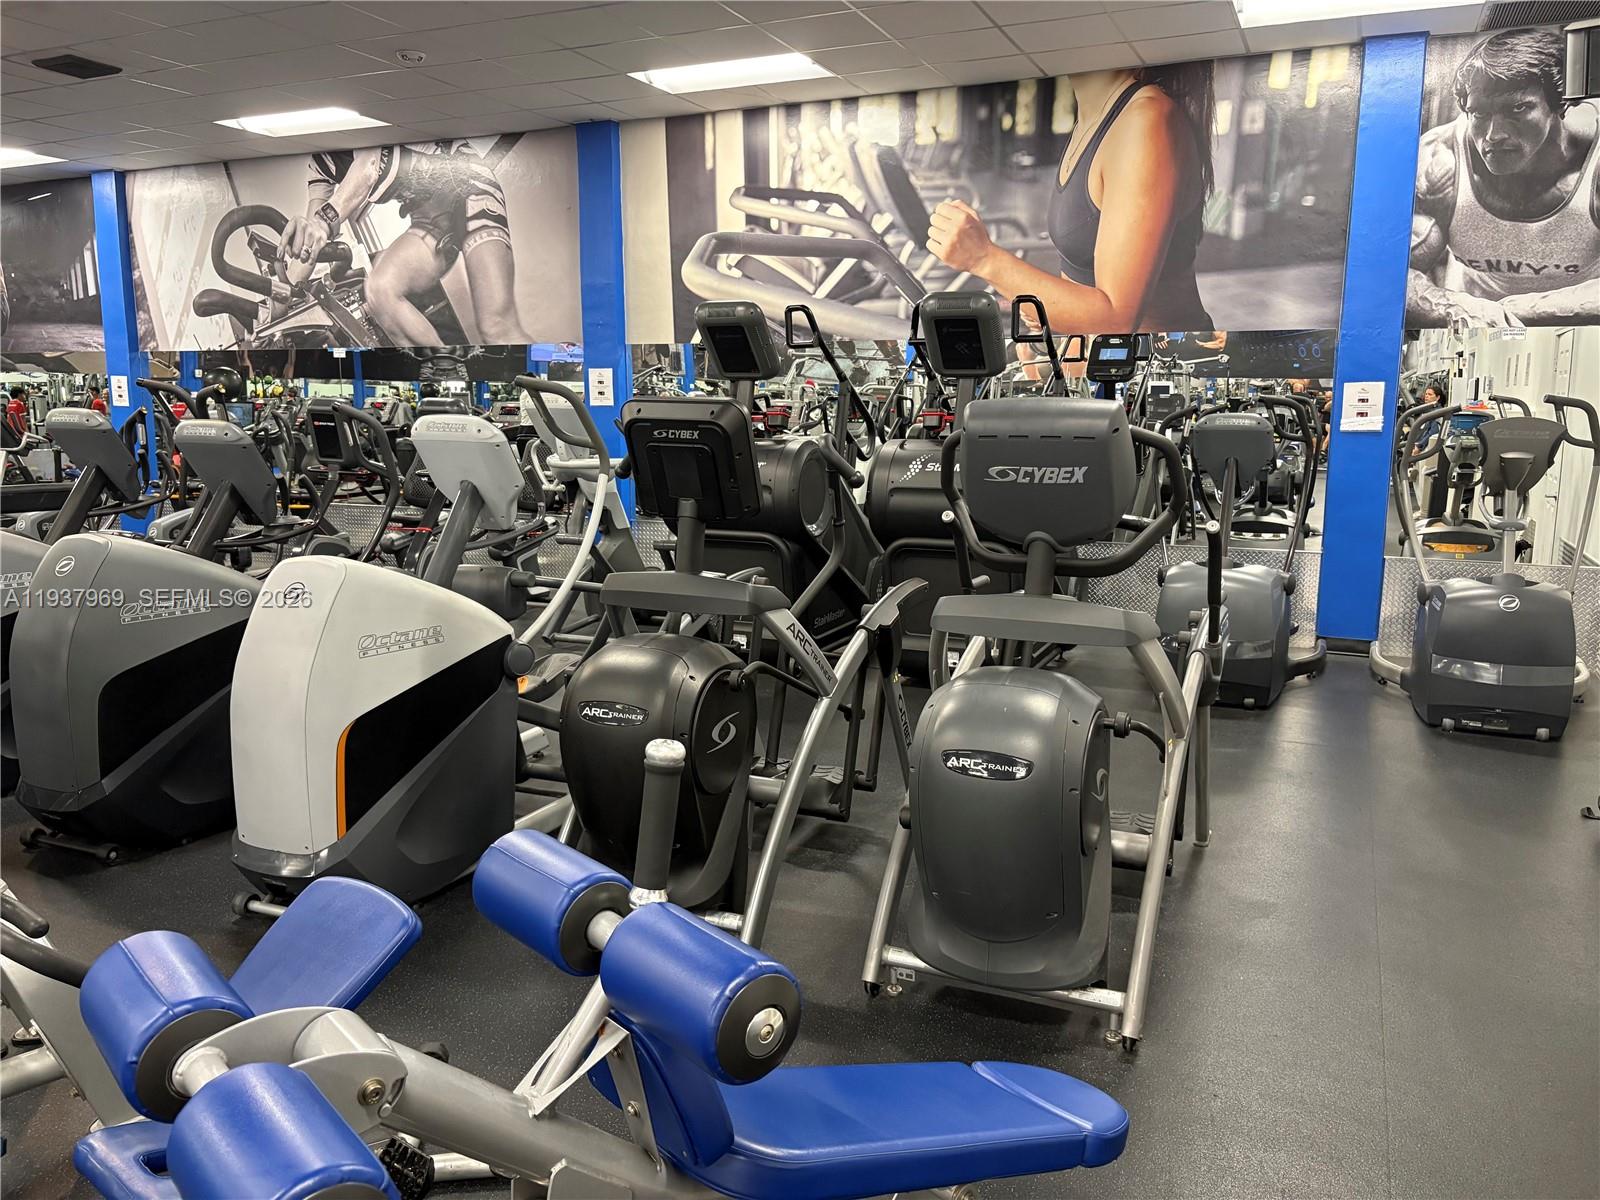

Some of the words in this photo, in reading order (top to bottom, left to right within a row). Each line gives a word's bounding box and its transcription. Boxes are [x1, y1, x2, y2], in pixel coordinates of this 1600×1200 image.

[668, 430, 700, 439] CYBEX
[1017, 466, 1089, 484] CYBEX
[358, 624, 442, 651] Octane
[361, 637, 441, 656] FITNESS
